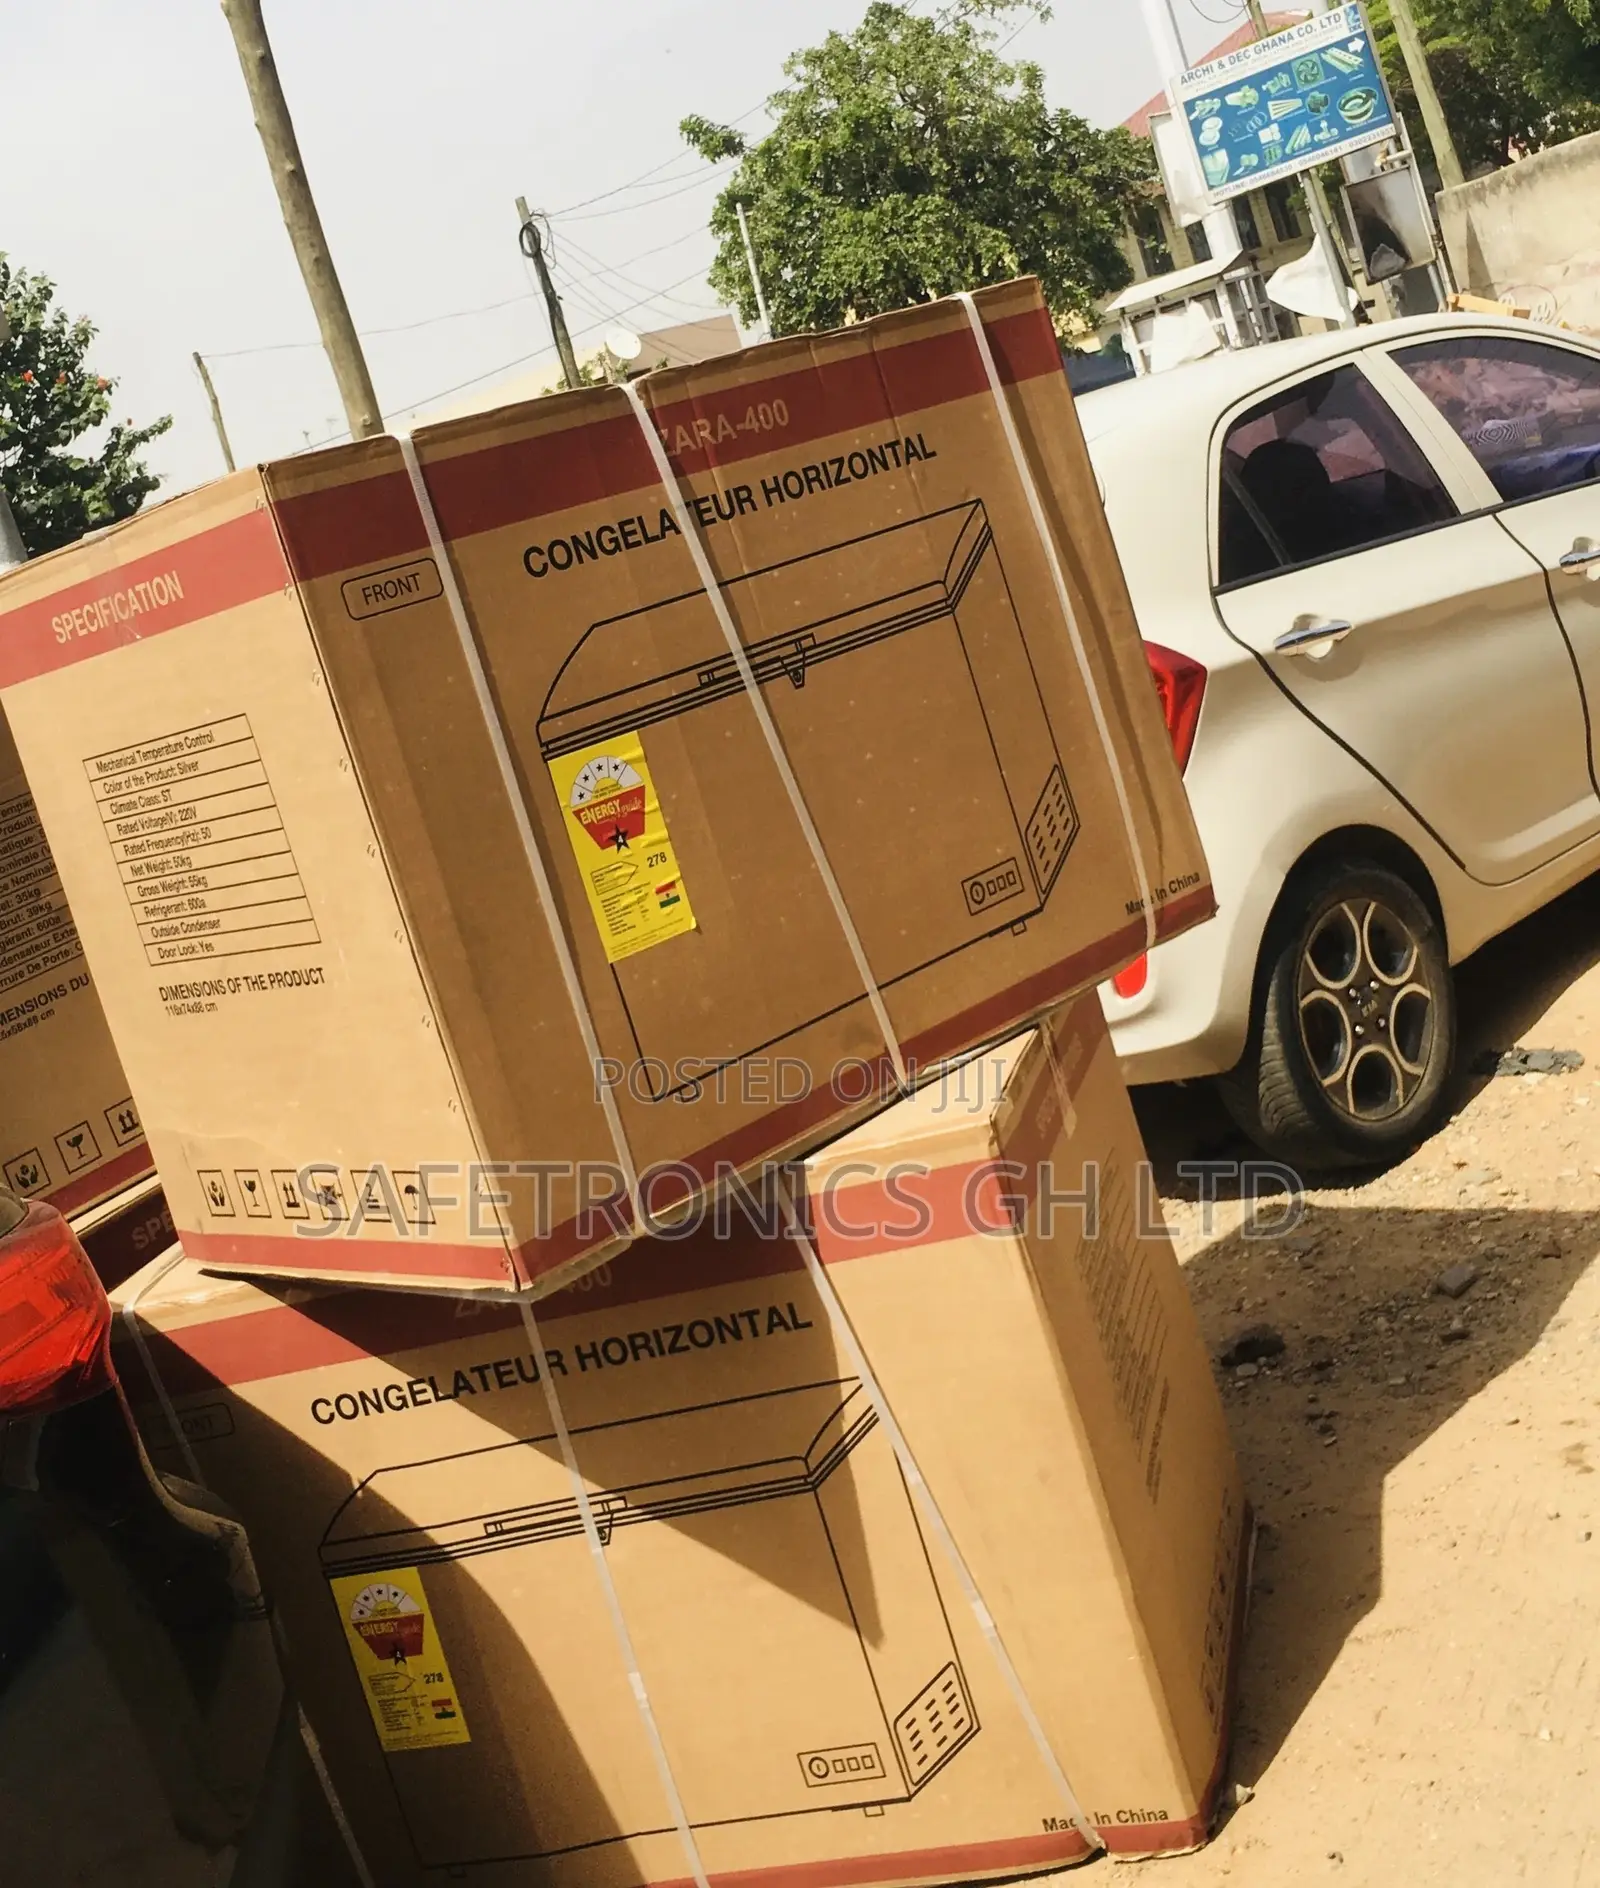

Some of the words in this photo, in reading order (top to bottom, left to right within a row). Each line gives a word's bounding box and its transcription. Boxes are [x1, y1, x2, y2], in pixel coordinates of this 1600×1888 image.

[1180, 64, 1214, 86] ARCHI
[1217, 59, 1226, 71] &
[1228, 50, 1252, 66] DEC
[1254, 33, 1295, 55] GHANA
[1297, 24, 1317, 38] CO.
[1320, 12, 1343, 29] LTD
[523, 484, 758, 578] CONGELAEUR
[760, 433, 937, 508] HORIZONTAL
[361, 572, 422, 606] FRONT
[52, 569, 185, 644] SPECIFICATION
[96, 752, 136, 773] Mechanical
[136, 742, 184, 762] Temperature
[184, 730, 215, 749] Control
[103, 779, 123, 794] Color
[124, 776, 133, 789] of
[132, 774, 145, 786] the
[145, 766, 177, 783] Product:
[177, 761, 199, 775] Silver
[110, 799, 138, 815] Climate
[161, 789, 172, 802] ST
[580, 799, 621, 824] ENERGY
[117, 822, 139, 836] Rated
[123, 841, 146, 856] Rated
[200, 826, 212, 839] 50
[130, 864, 145, 877] Net
[647, 852, 667, 868] 278
[137, 884, 160, 897] Gross
[1155, 887, 1167, 901] In
[1168, 872, 1200, 894] China
[150, 926, 180, 939] Outside
[180, 918, 221, 934] Condenser
[157, 945, 177, 959] Door
[179, 942, 198, 956] Lock:
[199, 941, 215, 953] Yes
[69, 973, 90, 991] DU
[159, 980, 227, 1002] DIMENSIONS
[227, 977, 243, 994] OF
[243, 973, 268, 992] THE
[267, 967, 326, 989] PRODUCT
[40, 1008, 56, 1020] cm
[204, 1002, 218, 1013] cm
[310, 1351, 569, 1425] CONGELATEUR
[574, 1302, 813, 1373] HORIZONTAL
[423, 1672, 445, 1685] 278
[1094, 1811, 1112, 1825] In
[1116, 1808, 1169, 1823] China
